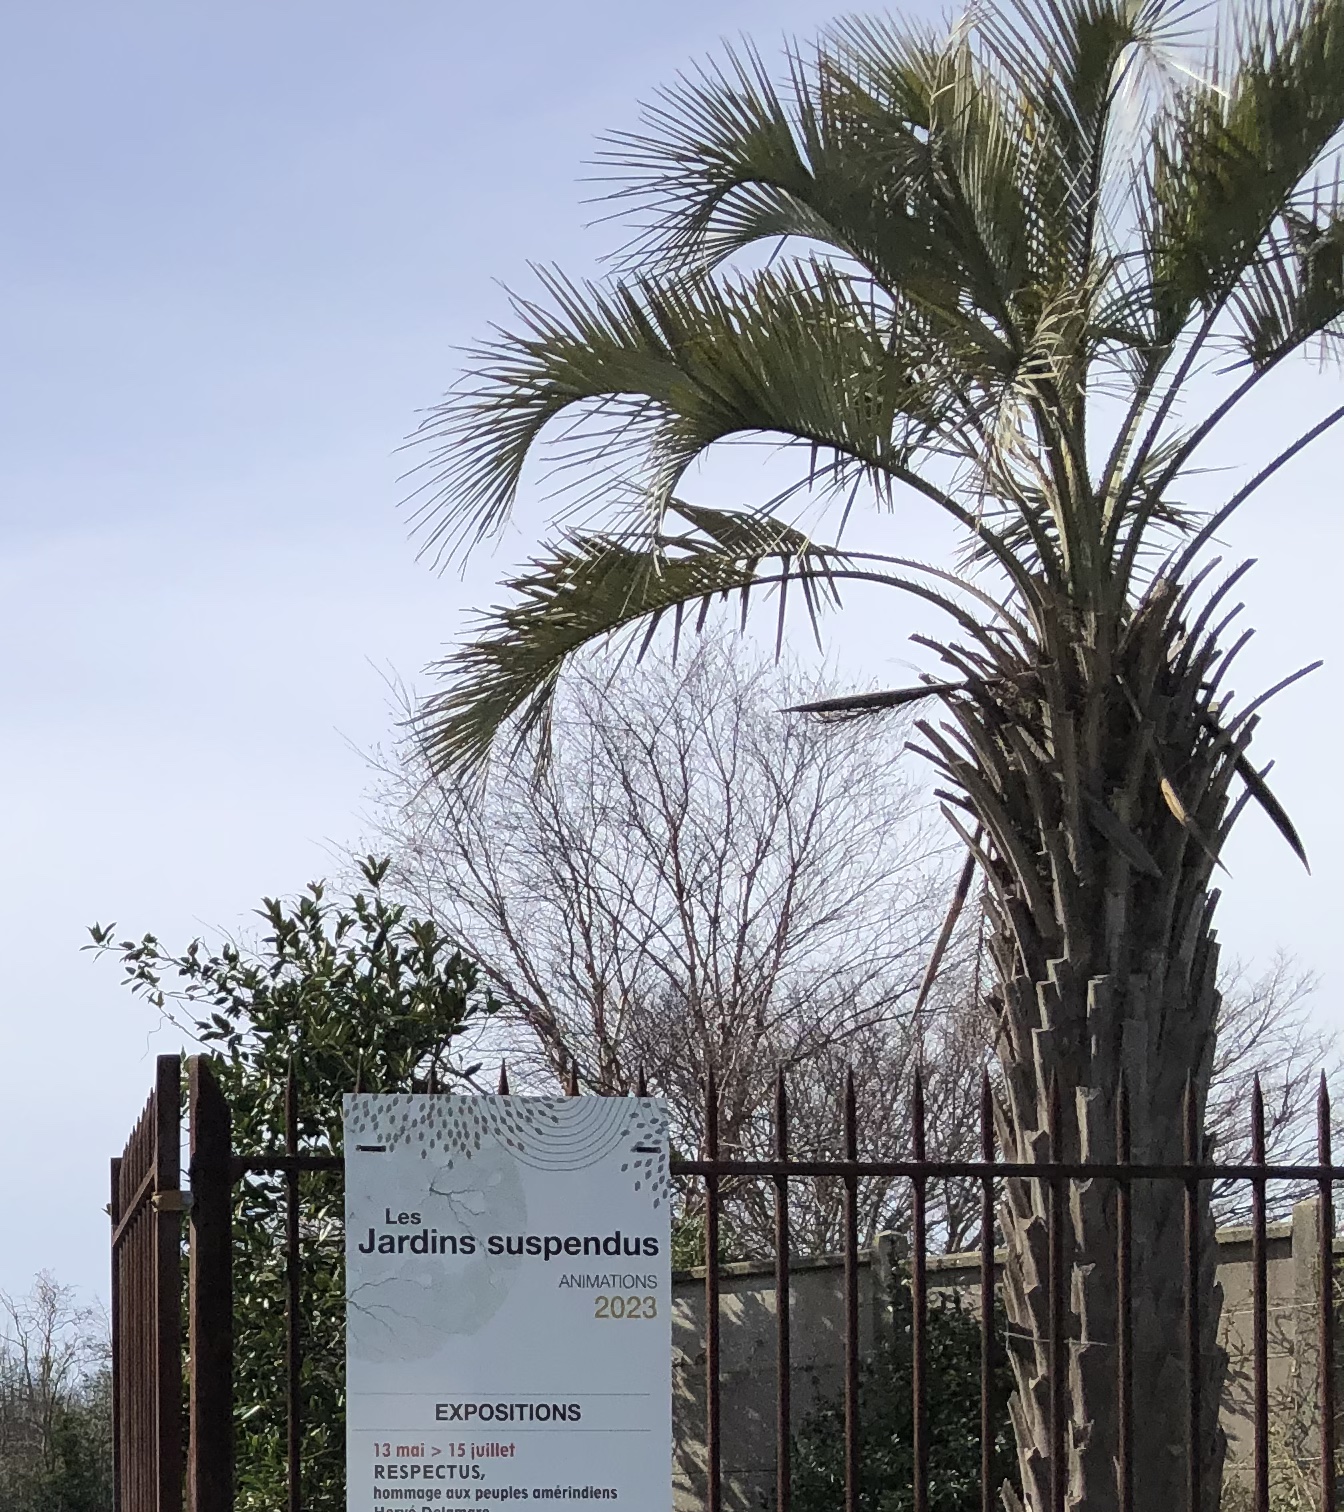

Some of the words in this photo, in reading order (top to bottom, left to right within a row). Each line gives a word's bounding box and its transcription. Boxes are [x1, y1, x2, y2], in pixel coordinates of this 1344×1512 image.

[385, 1207, 422, 1225] Les
[358, 1228, 476, 1255] Jardins
[487, 1231, 660, 1261] suspendus
[558, 1274, 658, 1289] ANIMATIONS
[594, 1295, 658, 1319] 2023
[435, 1403, 582, 1422] EXPOSITIONS
[373, 1442, 391, 1458] 13
[396, 1442, 425, 1458] mai
[448, 1442, 466, 1458] 15
[470, 1442, 516, 1460] juillet
[374, 1464, 486, 1481] RESPECTUS,
[373, 1486, 442, 1501] hommage
[445, 1488, 470, 1499] aux
[475, 1486, 529, 1501] peuples
[532, 1484, 618, 1500] amérindiens
